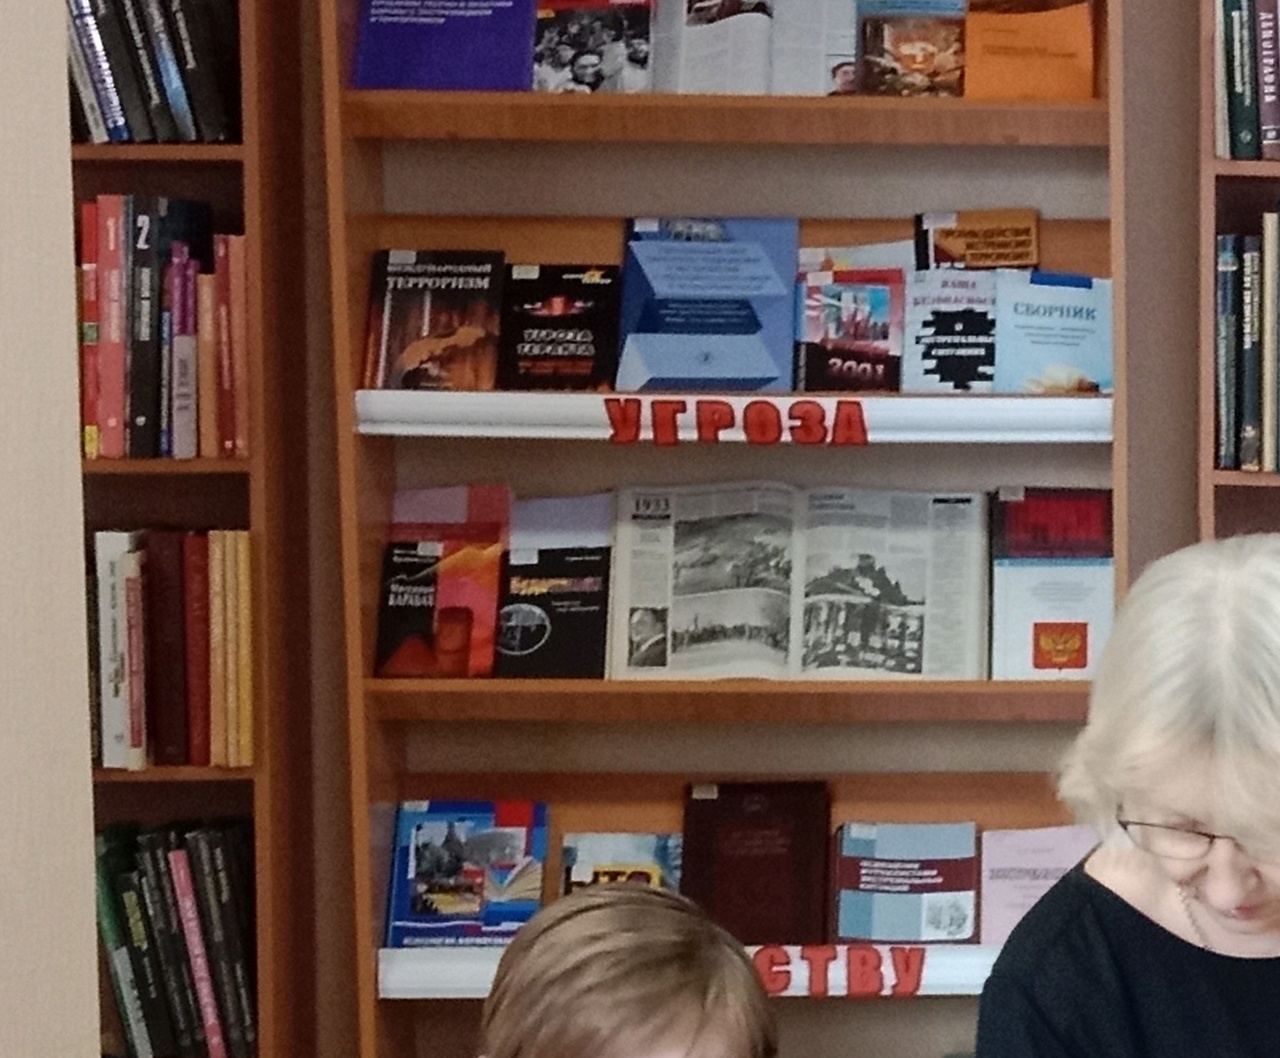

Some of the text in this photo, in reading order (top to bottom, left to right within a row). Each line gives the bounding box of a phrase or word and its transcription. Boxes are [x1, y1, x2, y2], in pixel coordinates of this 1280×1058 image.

[106, 218, 116, 250] 1
[136, 215, 150, 249] 2
[386, 276, 491, 290] ТЕРРОРИЗМ
[1013, 302, 1097, 321] СБОРНИК
[604, 397, 869, 446] УГРОЗА
[752, 944, 926, 998] СТВУ
